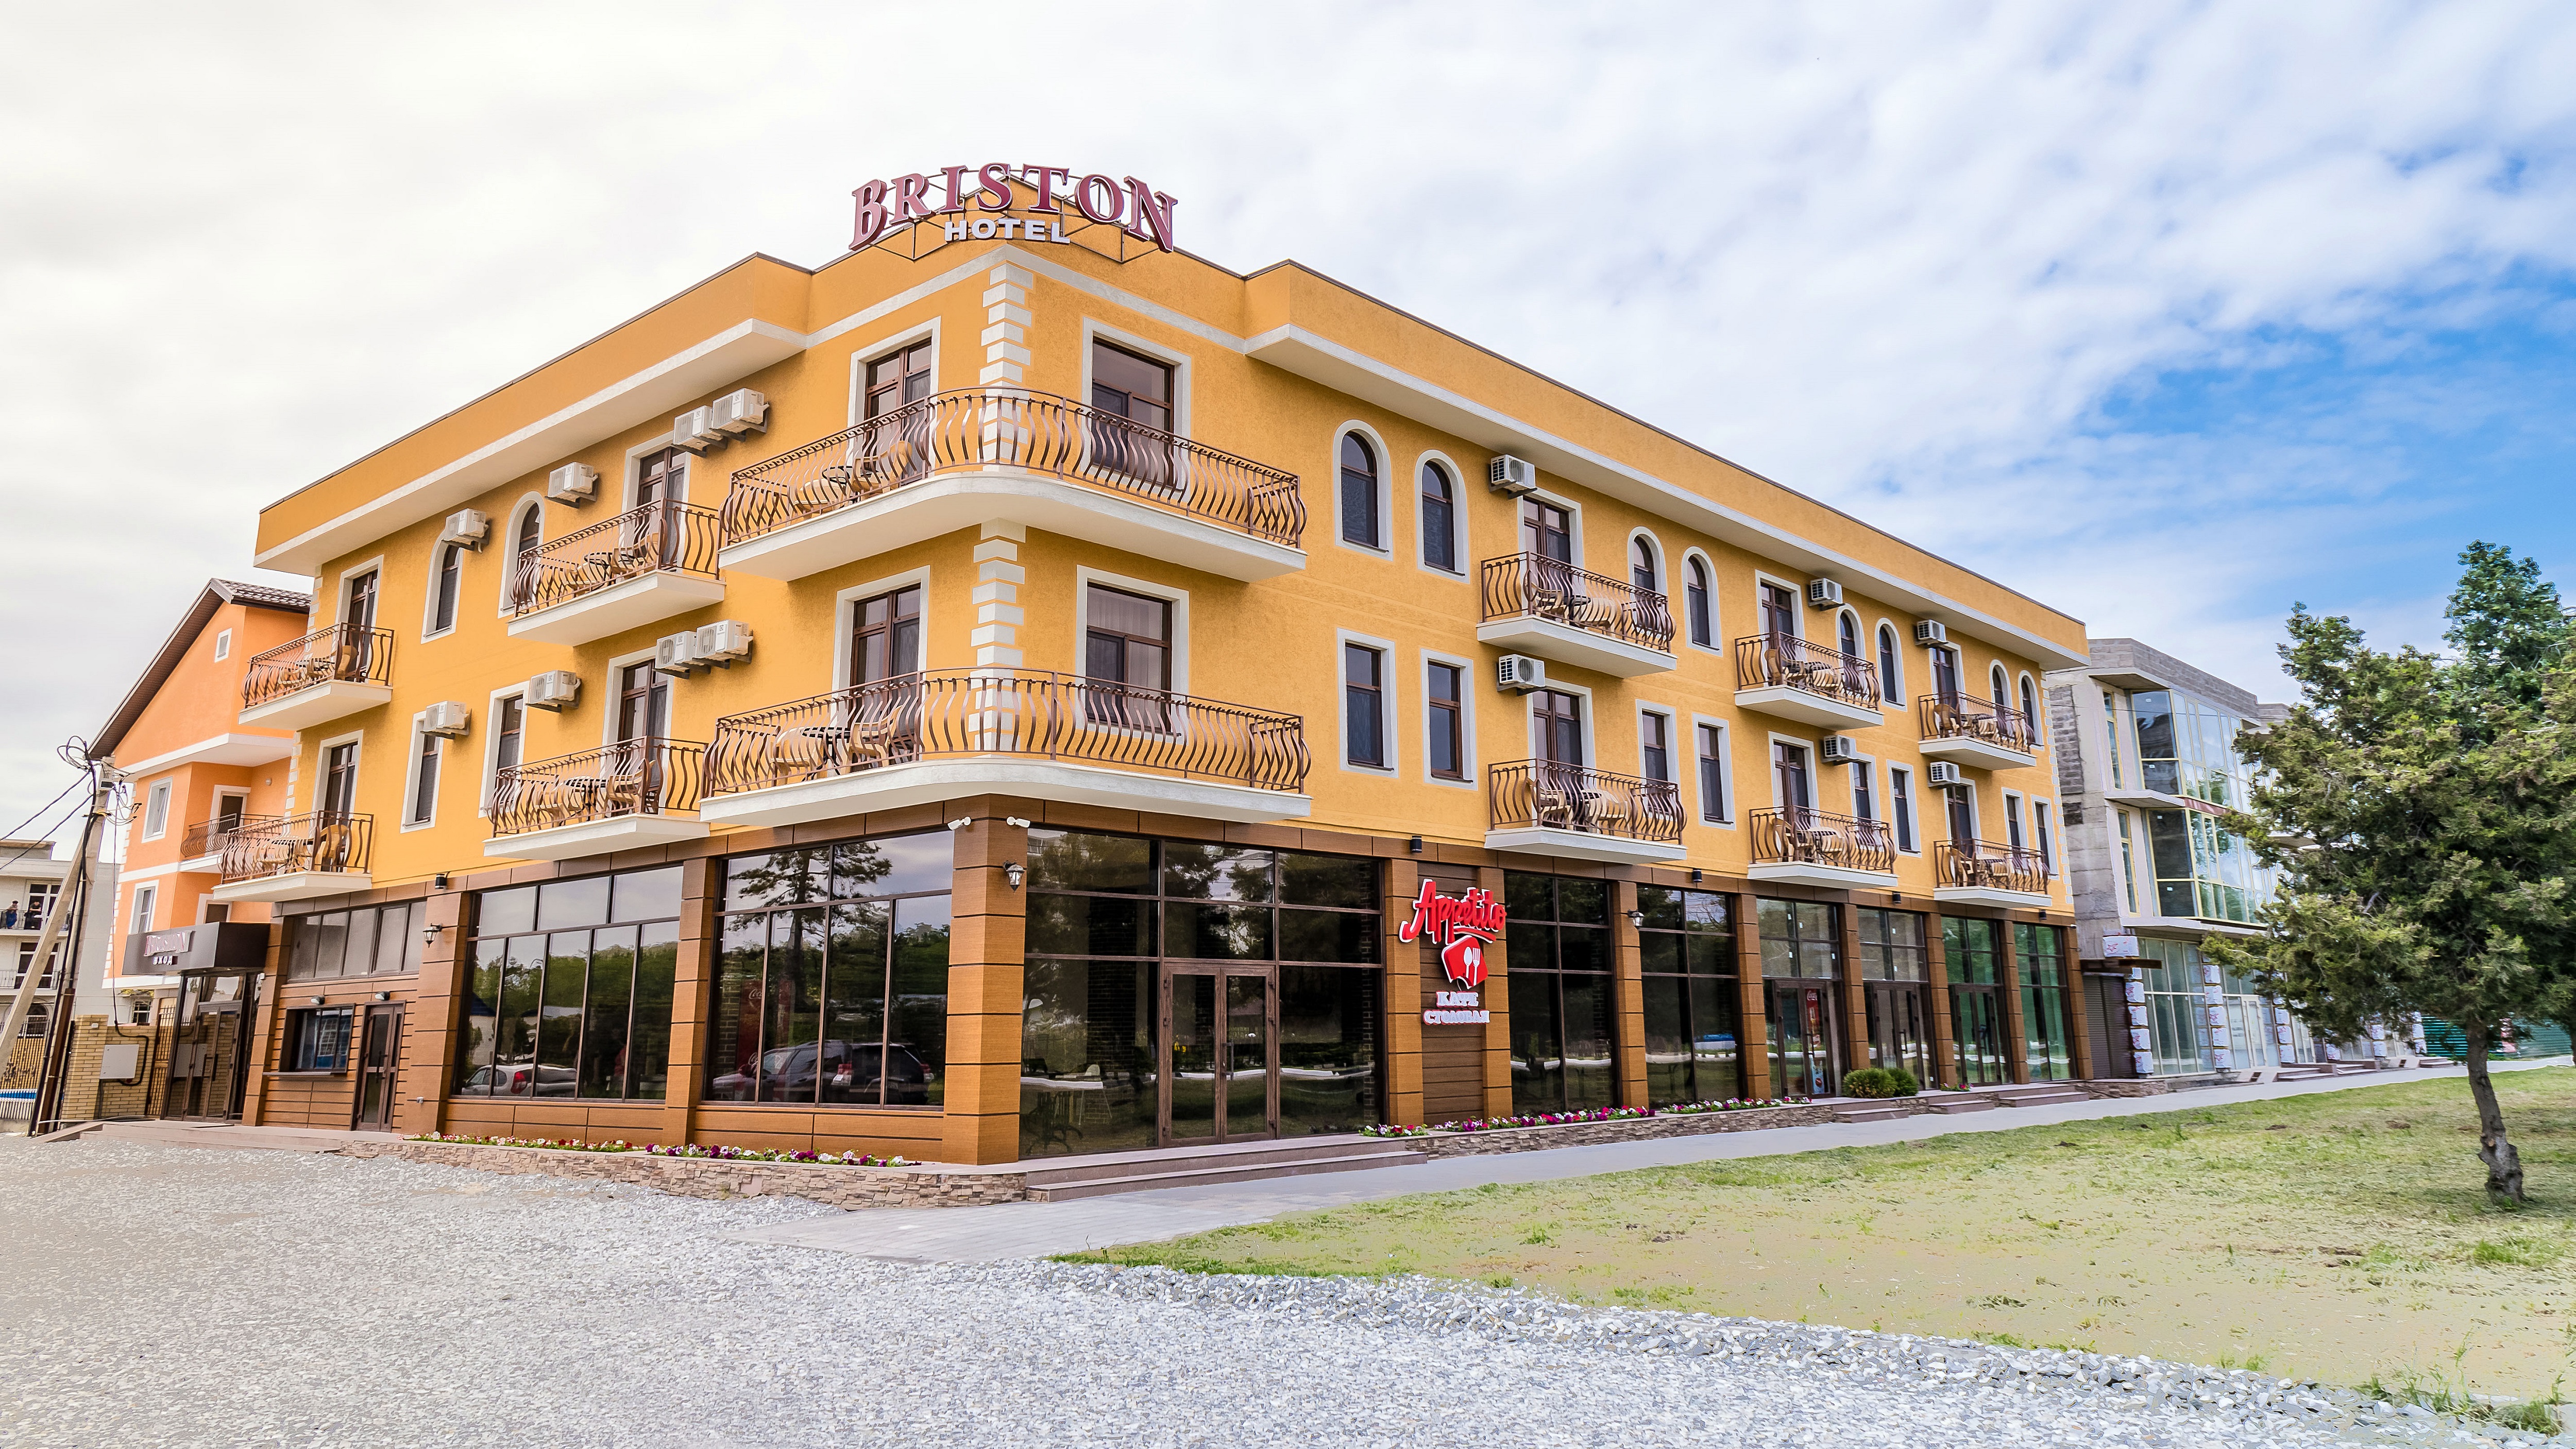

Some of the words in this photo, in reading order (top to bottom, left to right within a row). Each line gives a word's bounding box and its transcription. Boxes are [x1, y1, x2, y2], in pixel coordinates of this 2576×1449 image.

[849, 162, 1178, 252] BRISTON
[944, 218, 1070, 244] HOTEL
[1399, 878, 1507, 945] Appetito
[1436, 991, 1479, 1007] КАФЕ
[1423, 1010, 1490, 1025] СТОЛОВАЯ
